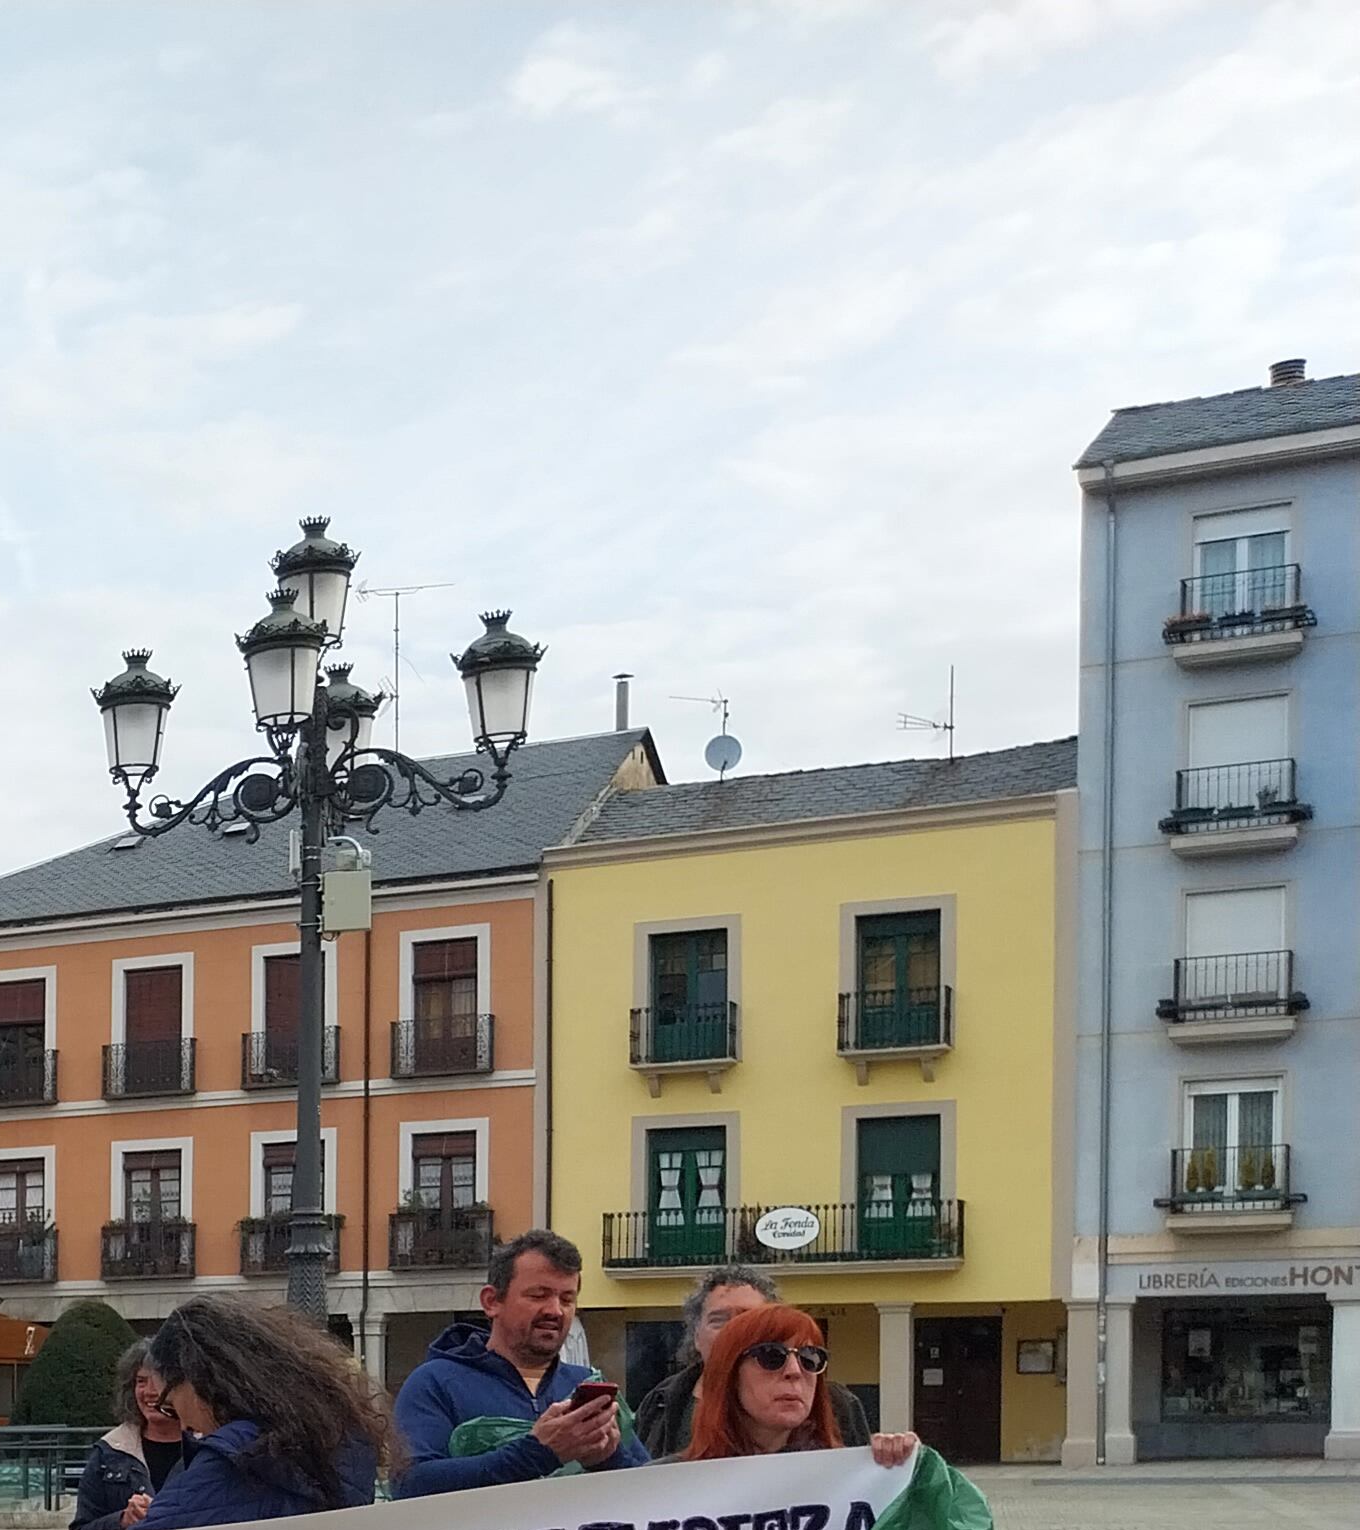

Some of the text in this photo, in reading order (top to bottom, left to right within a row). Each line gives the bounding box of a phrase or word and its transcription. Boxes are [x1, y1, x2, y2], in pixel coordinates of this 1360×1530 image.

[760, 1216, 815, 1232] La Fonda
[1139, 1265, 1360, 1290] LIBRERÍA EDICIONES HON
